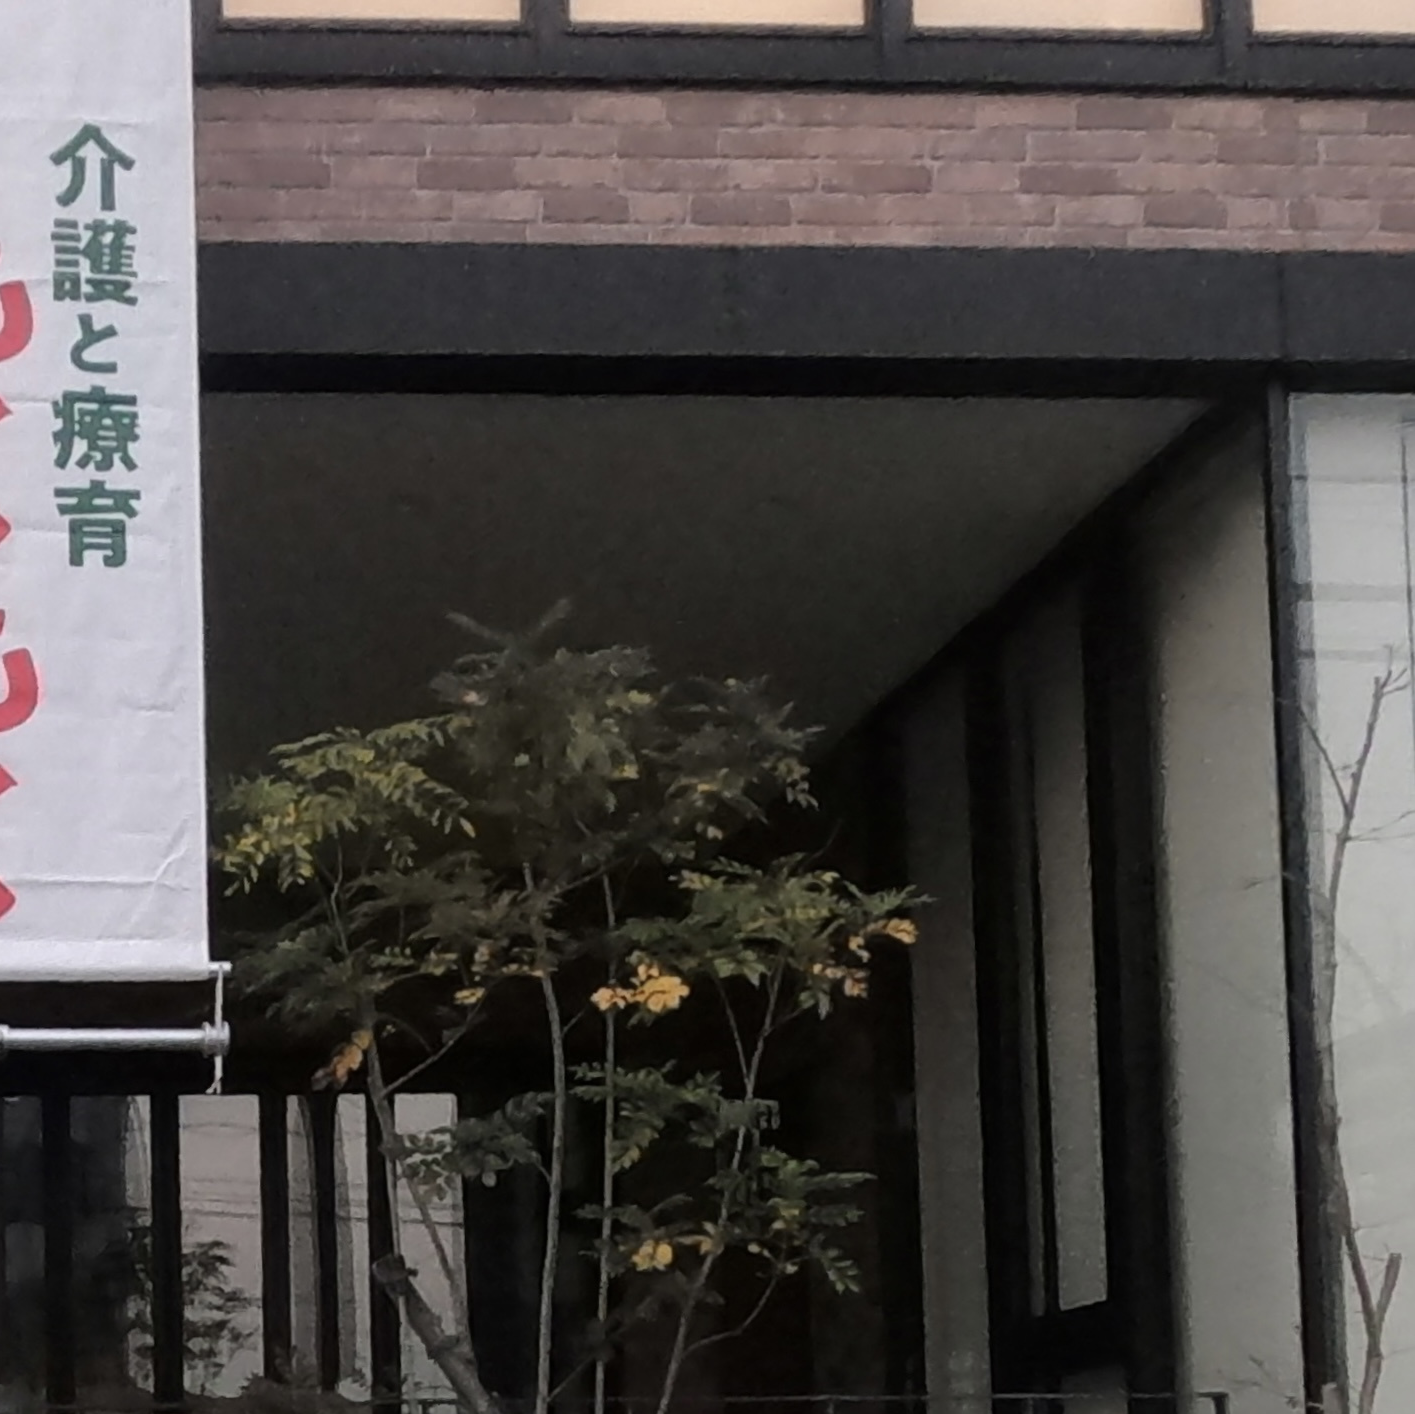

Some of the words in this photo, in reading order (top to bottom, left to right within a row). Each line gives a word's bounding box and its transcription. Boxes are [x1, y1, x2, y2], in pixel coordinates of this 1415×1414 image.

[49, 123, 141, 569] 介護と療育
